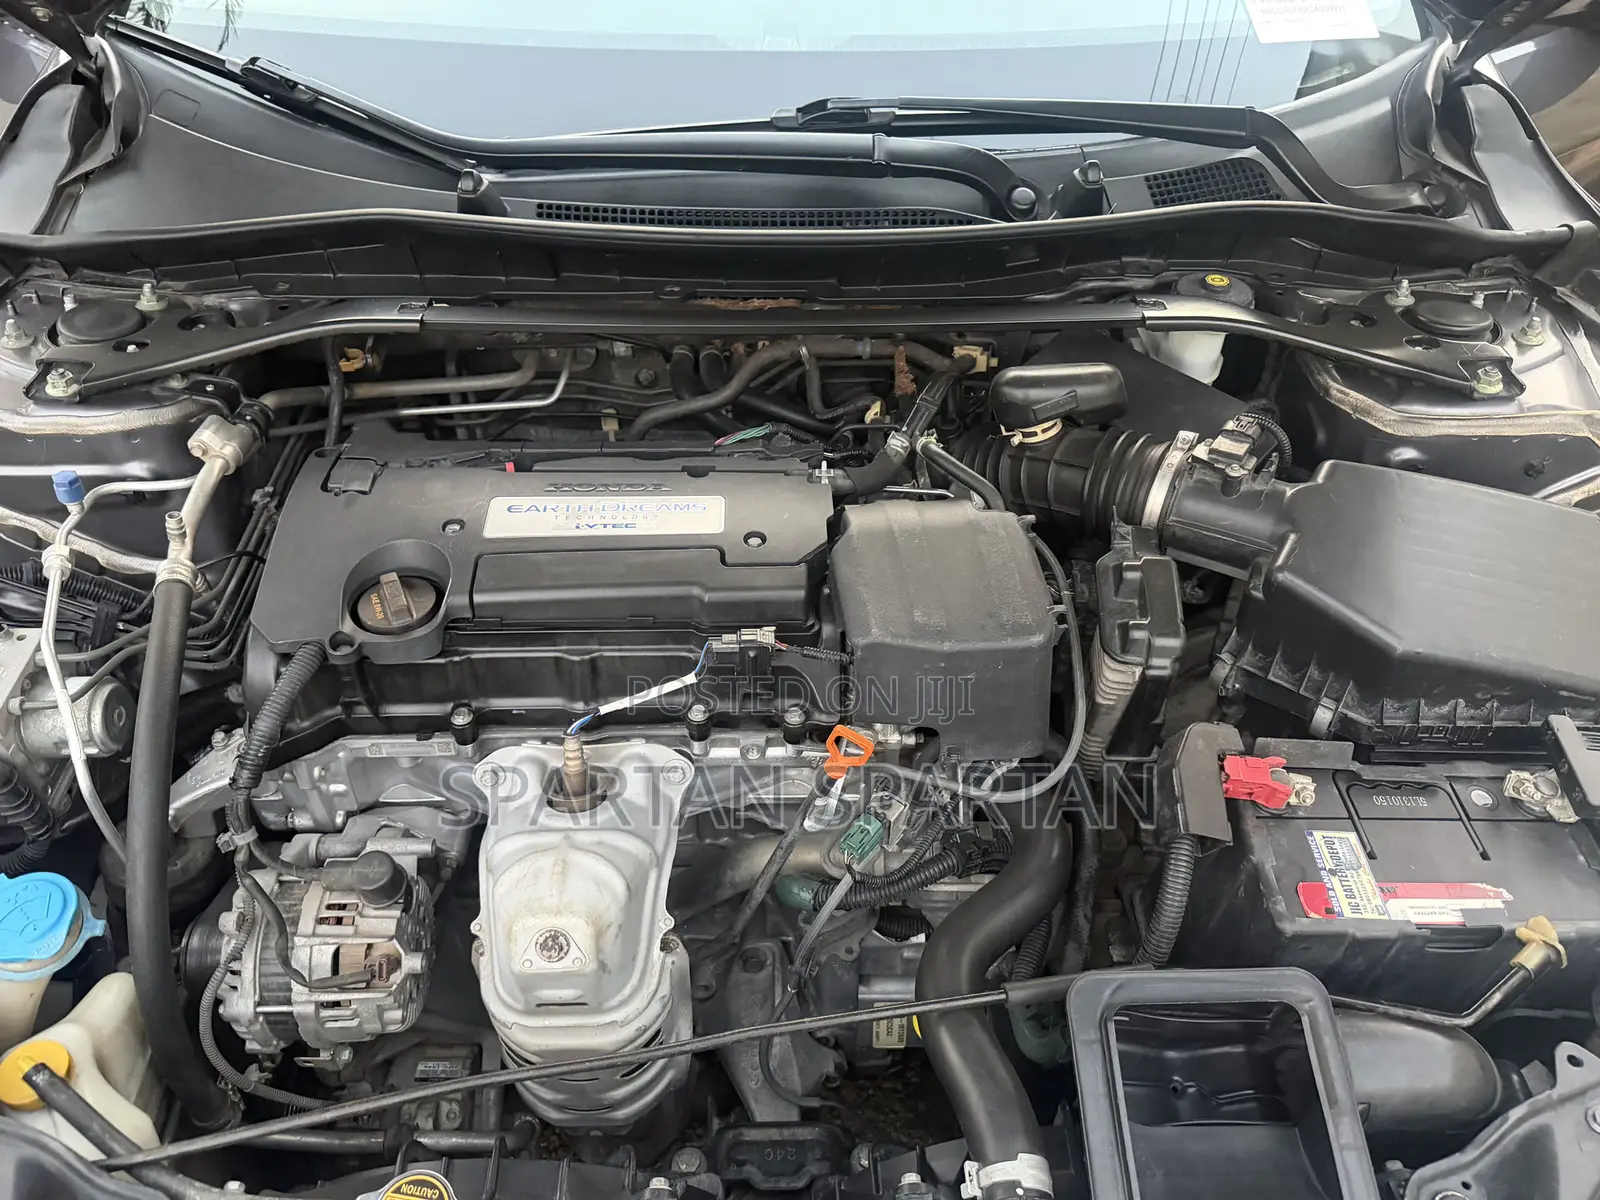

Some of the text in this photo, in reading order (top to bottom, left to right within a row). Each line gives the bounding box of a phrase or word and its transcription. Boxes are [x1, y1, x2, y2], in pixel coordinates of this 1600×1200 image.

[544, 483, 673, 493] HONDA
[507, 502, 709, 514] EARTH DREAMS
[1372, 795, 1428, 807] 5L1310150
[1322, 835, 1341, 861] DEPOT
[1308, 835, 1342, 915] SOLD AND SERVICE
[1334, 860, 1358, 900] BATTERY
[400, 1183, 440, 1199] CAUTION
